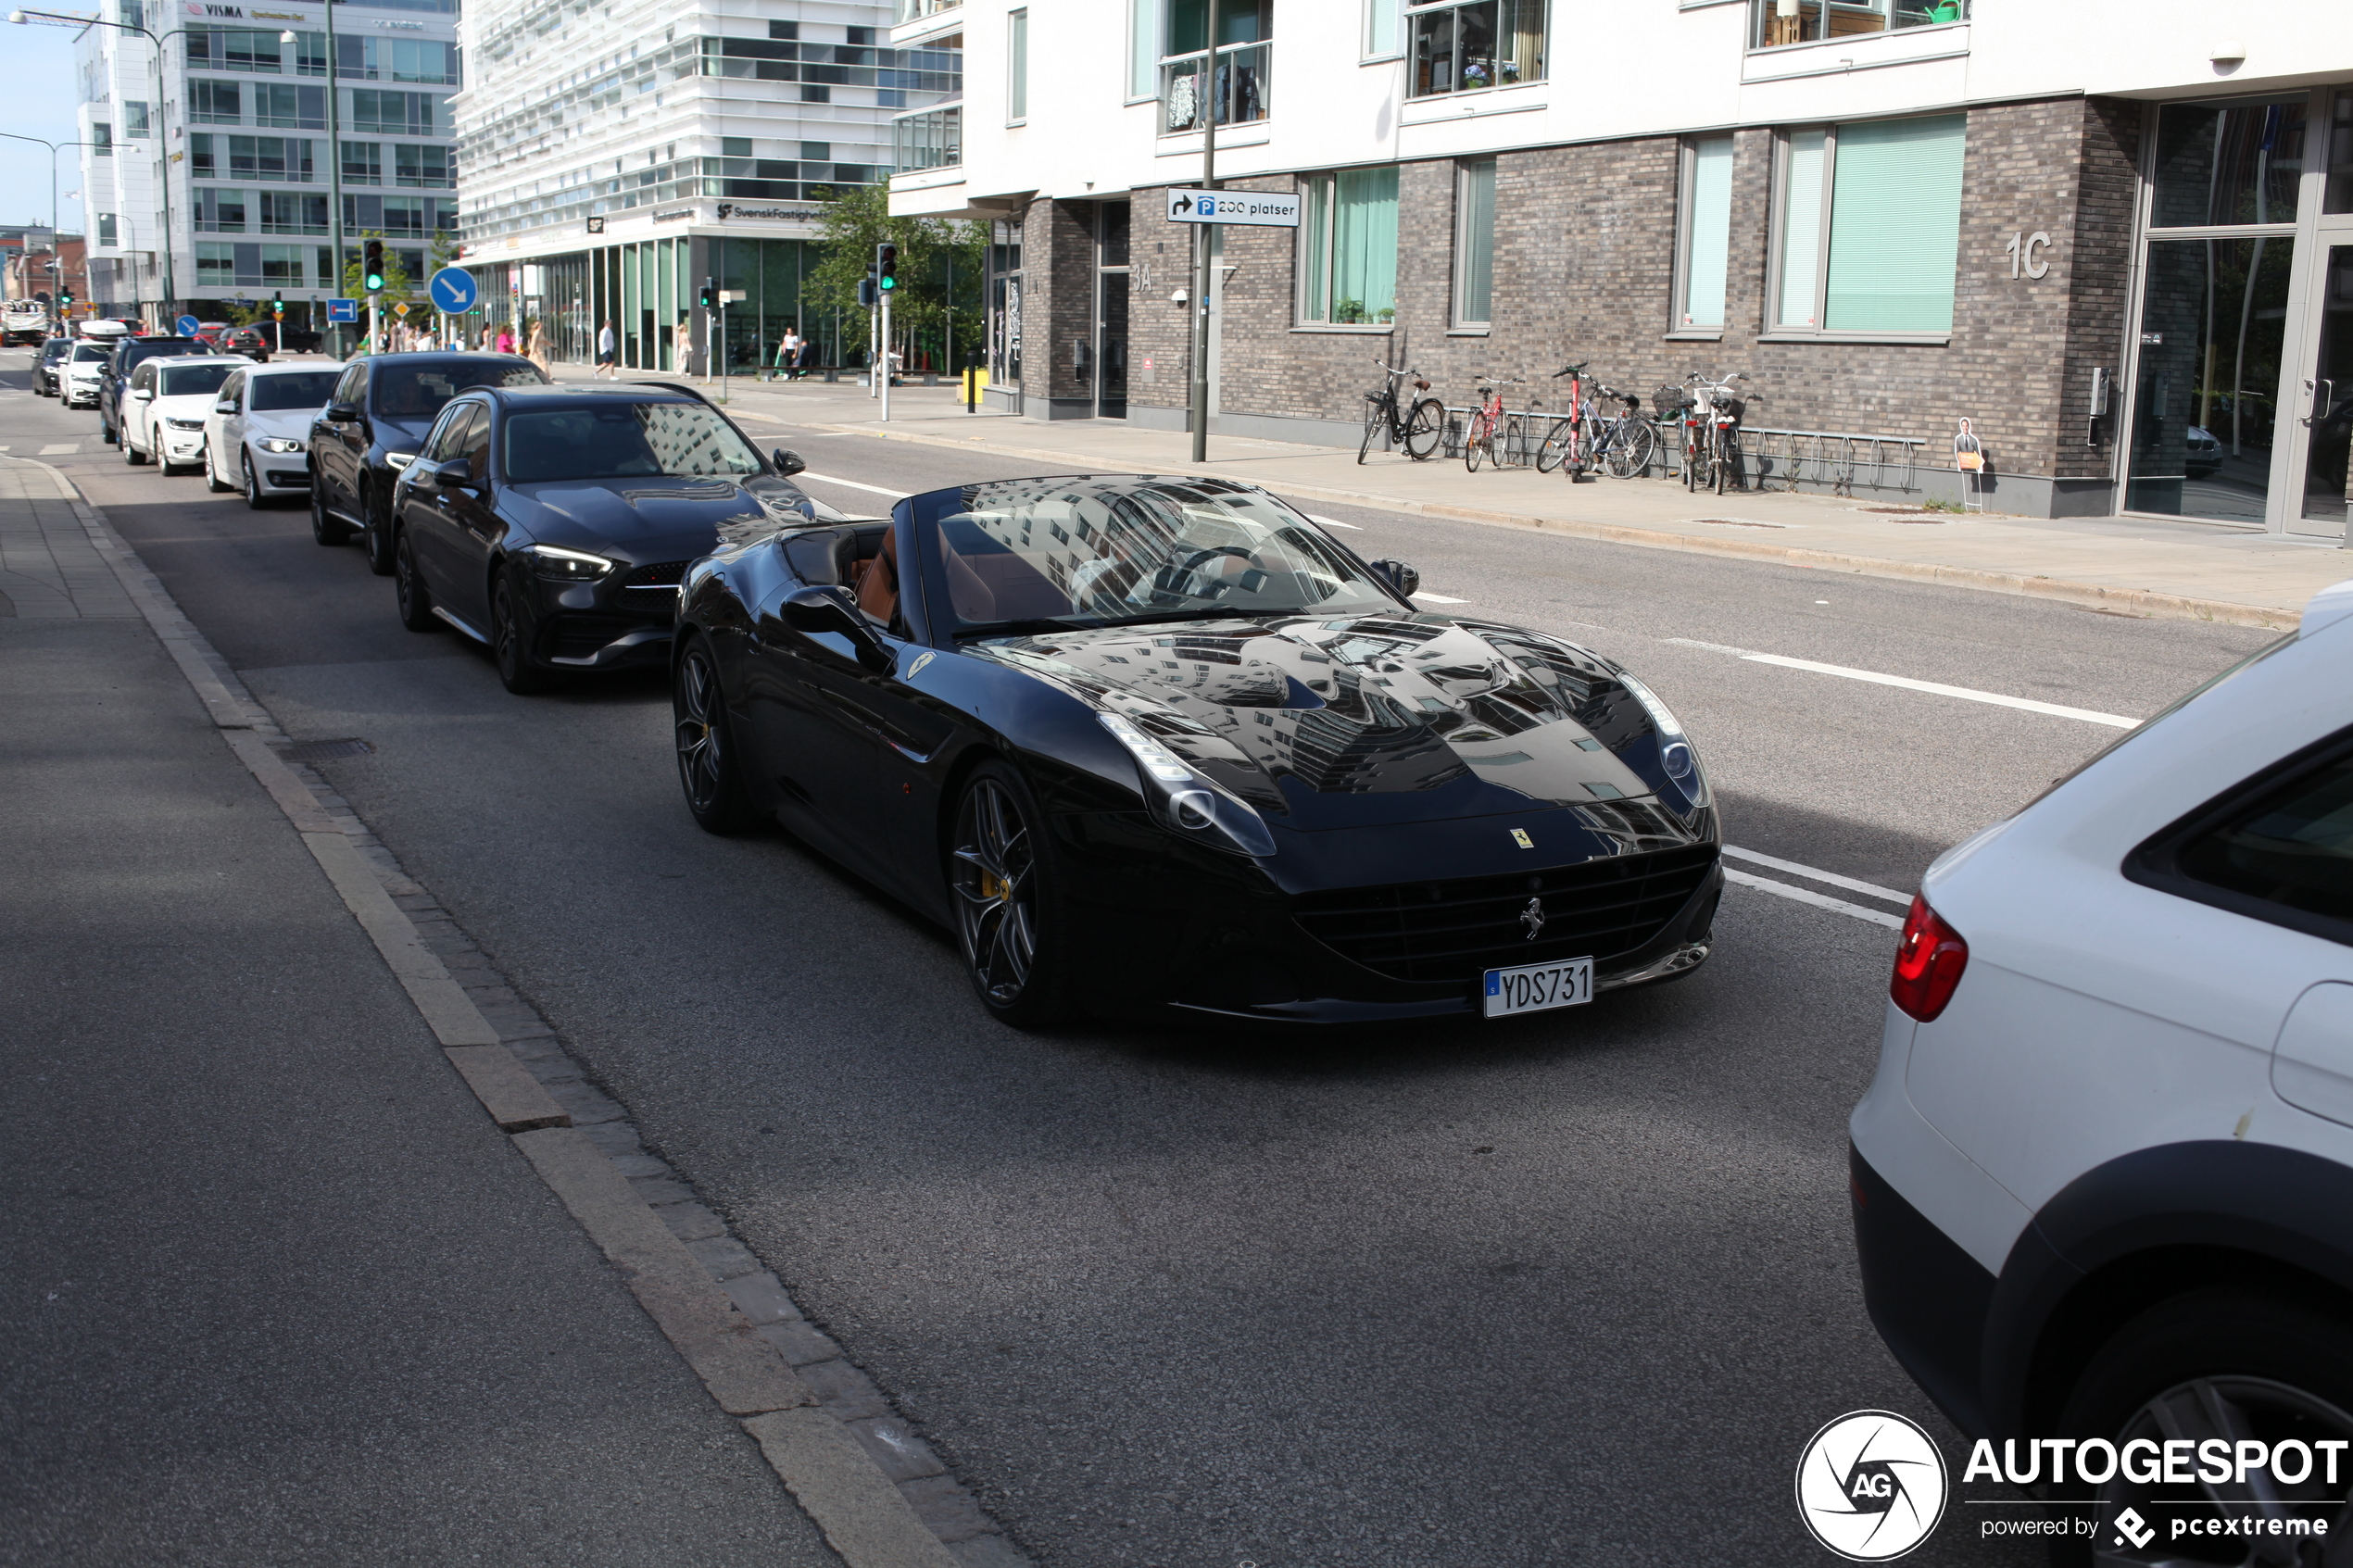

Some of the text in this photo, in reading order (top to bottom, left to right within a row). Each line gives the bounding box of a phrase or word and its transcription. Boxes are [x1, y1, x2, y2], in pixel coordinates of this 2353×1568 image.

[206, 4, 244, 19] VISMA
[1218, 201, 1245, 213] 200
[1250, 203, 1295, 216] platser
[2007, 232, 2051, 280] 1C
[1133, 263, 1152, 292] 3A
